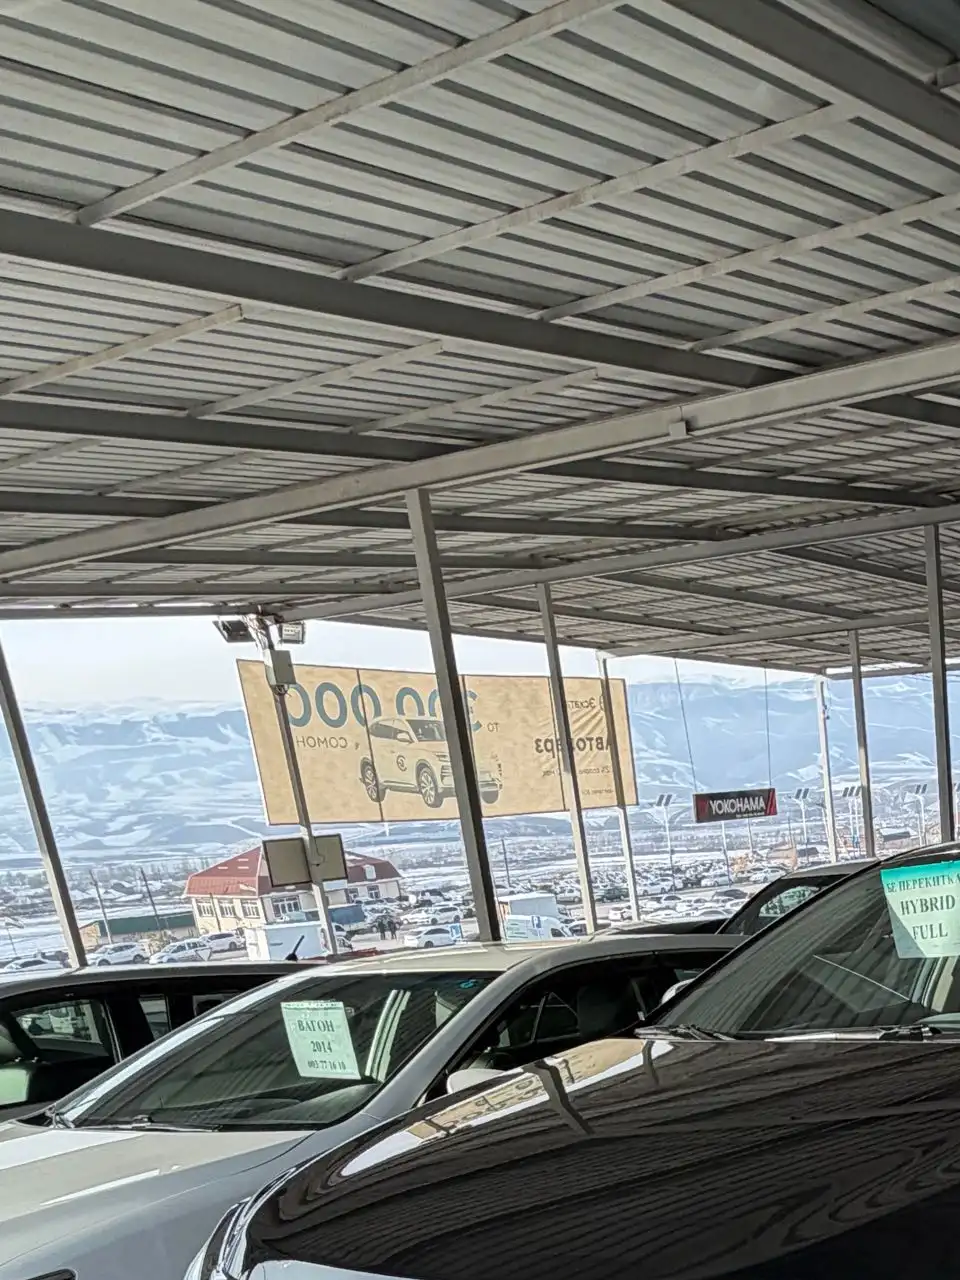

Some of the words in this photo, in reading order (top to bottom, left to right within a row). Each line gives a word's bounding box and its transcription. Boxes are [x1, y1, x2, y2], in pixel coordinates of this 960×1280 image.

[709, 796, 767, 815] YOKOHAMA
[899, 894, 956, 916] HYBRID
[911, 920, 949, 940] FULL
[297, 1020, 335, 1032] ВАГОН
[310, 1040, 333, 1053] 2014
